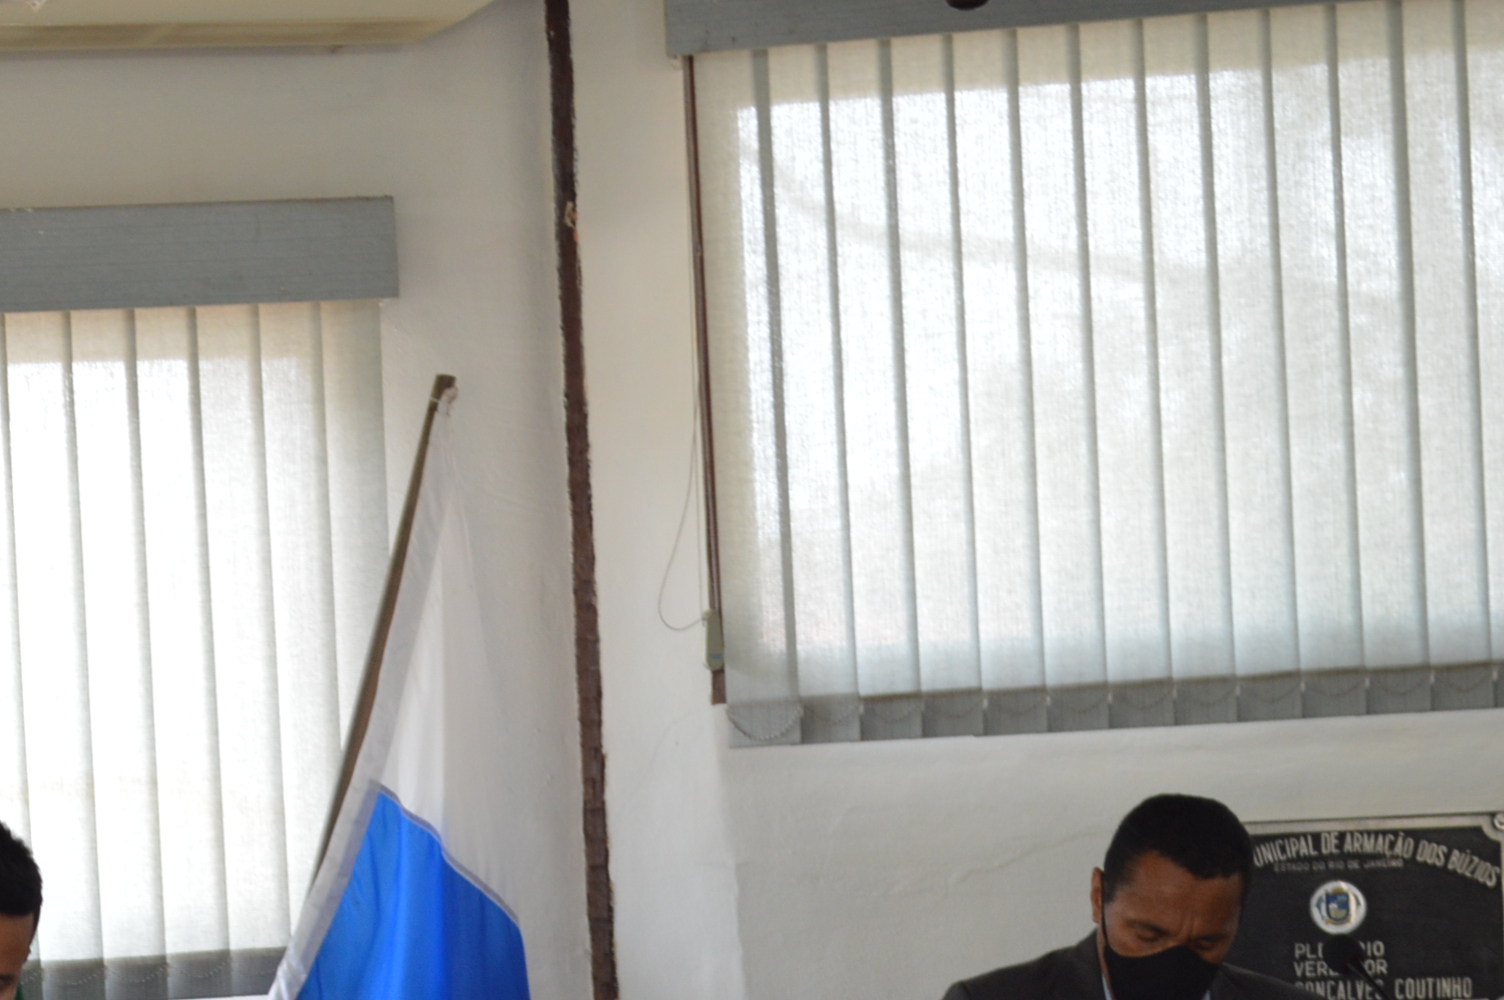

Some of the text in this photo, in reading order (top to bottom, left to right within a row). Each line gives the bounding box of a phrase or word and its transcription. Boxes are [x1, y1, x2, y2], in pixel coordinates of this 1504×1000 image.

[1253, 830, 1500, 887] UNICIPAL DE ARMAÇÃO DOS BÚZIOS
[1395, 977, 1473, 1000] COUTINHO
